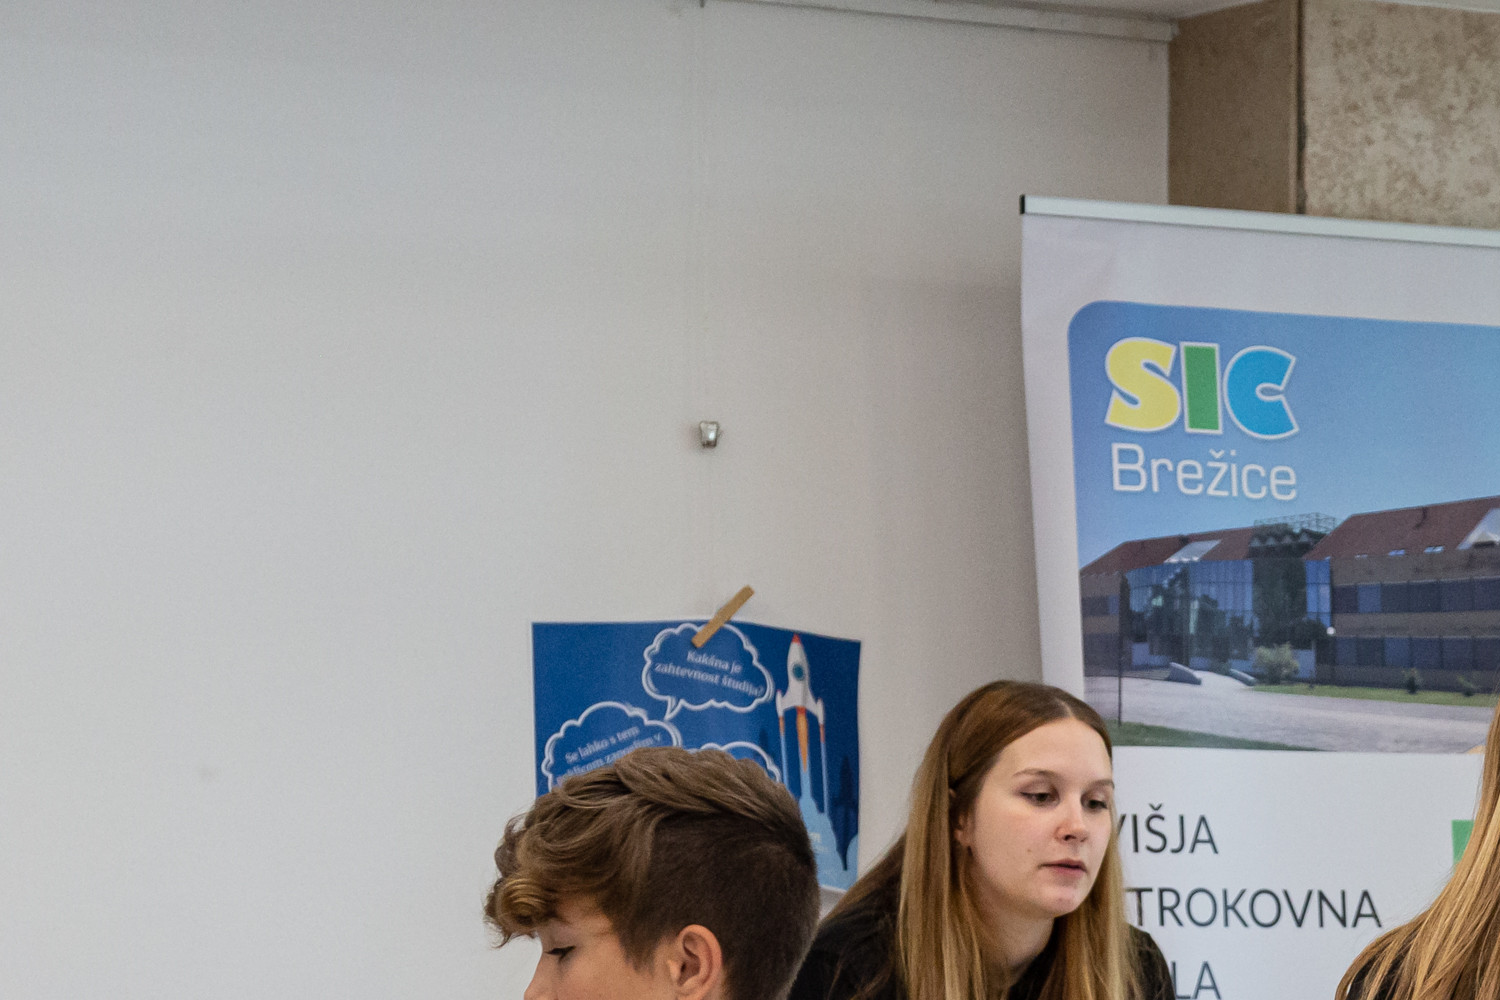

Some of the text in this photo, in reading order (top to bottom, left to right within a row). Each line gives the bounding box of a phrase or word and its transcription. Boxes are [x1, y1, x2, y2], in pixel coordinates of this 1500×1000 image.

[1104, 336, 1300, 440] SIC
[1111, 442, 1297, 501] Brežice
[654, 662, 720, 685] zahtevnost
[1125, 887, 1382, 929] TROKOVNA
[1171, 960, 1222, 1000] LA
